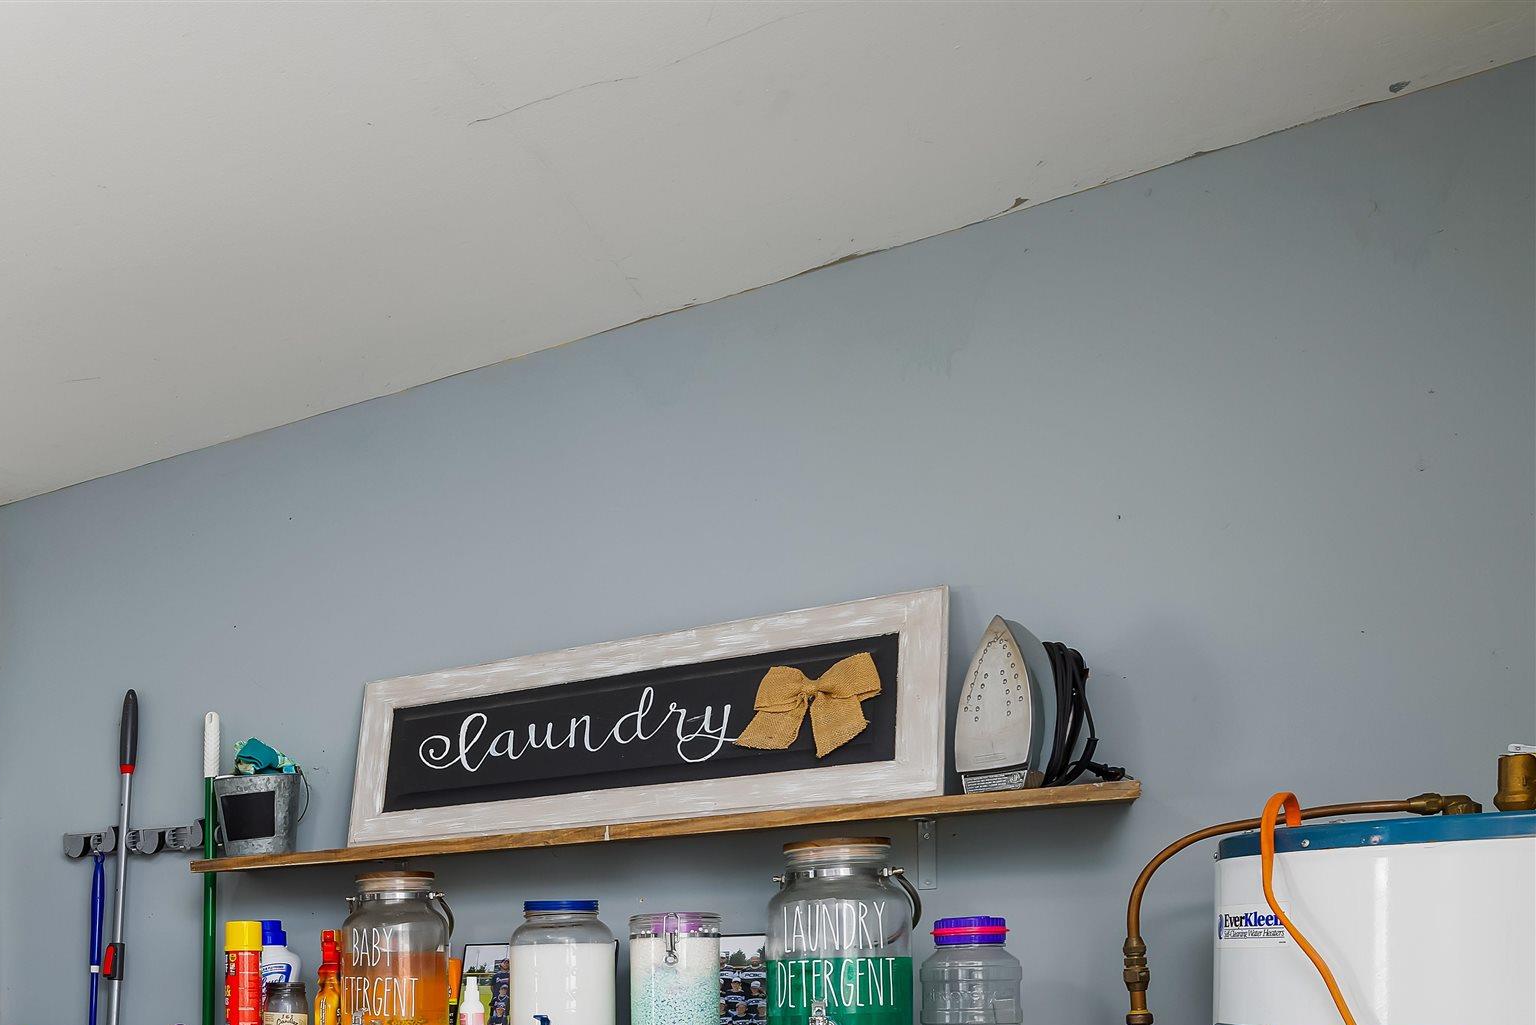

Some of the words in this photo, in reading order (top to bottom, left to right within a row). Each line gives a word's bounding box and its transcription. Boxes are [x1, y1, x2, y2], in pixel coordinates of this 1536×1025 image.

[352, 927, 394, 967] BABY
[782, 901, 887, 954] LAUNDRY
[777, 957, 897, 1008] DETERGENT
